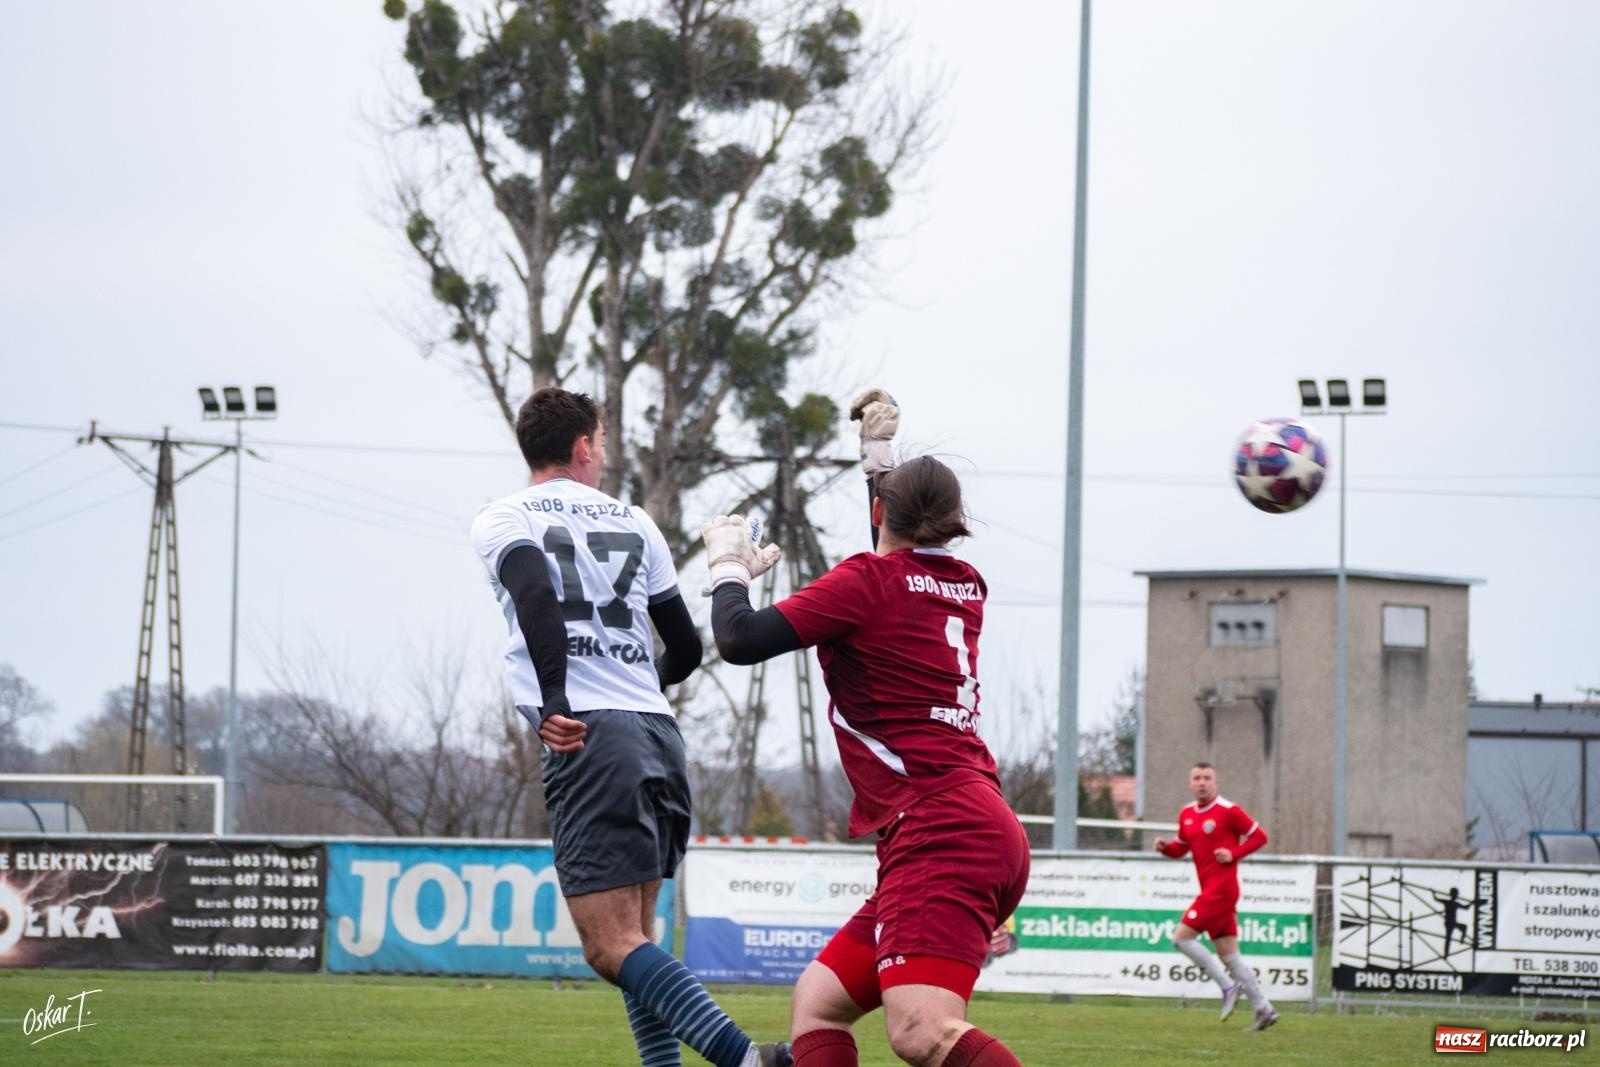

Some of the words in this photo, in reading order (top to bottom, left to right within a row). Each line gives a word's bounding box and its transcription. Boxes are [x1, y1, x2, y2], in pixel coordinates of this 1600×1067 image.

[522, 498, 564, 512] 1908
[571, 503, 634, 520] NĘDZA
[543, 525, 645, 630] 17
[945, 615, 980, 713] 1
[16, 852, 154, 872] ELEKTRYCZNE
[233, 854, 260, 867] 603
[291, 856, 318, 869] 967
[234, 874, 260, 886] 607
[264, 874, 289, 887] 336
[729, 878, 797, 896] energy
[233, 896, 259, 909] 603
[262, 896, 288, 909] 798
[291, 898, 319, 910] 977
[1477, 872, 1494, 948] WYNAJEM
[291, 917, 318, 929] 762
[527, 952, 588, 969] www.jo
[1544, 959, 1569, 973] 538
[1573, 960, 1598, 974] 300
[1120, 963, 1161, 981] +48
[1268, 968, 1309, 986] 735
[1354, 971, 1392, 989] PNG
[1394, 972, 1463, 991] SYSTEM
